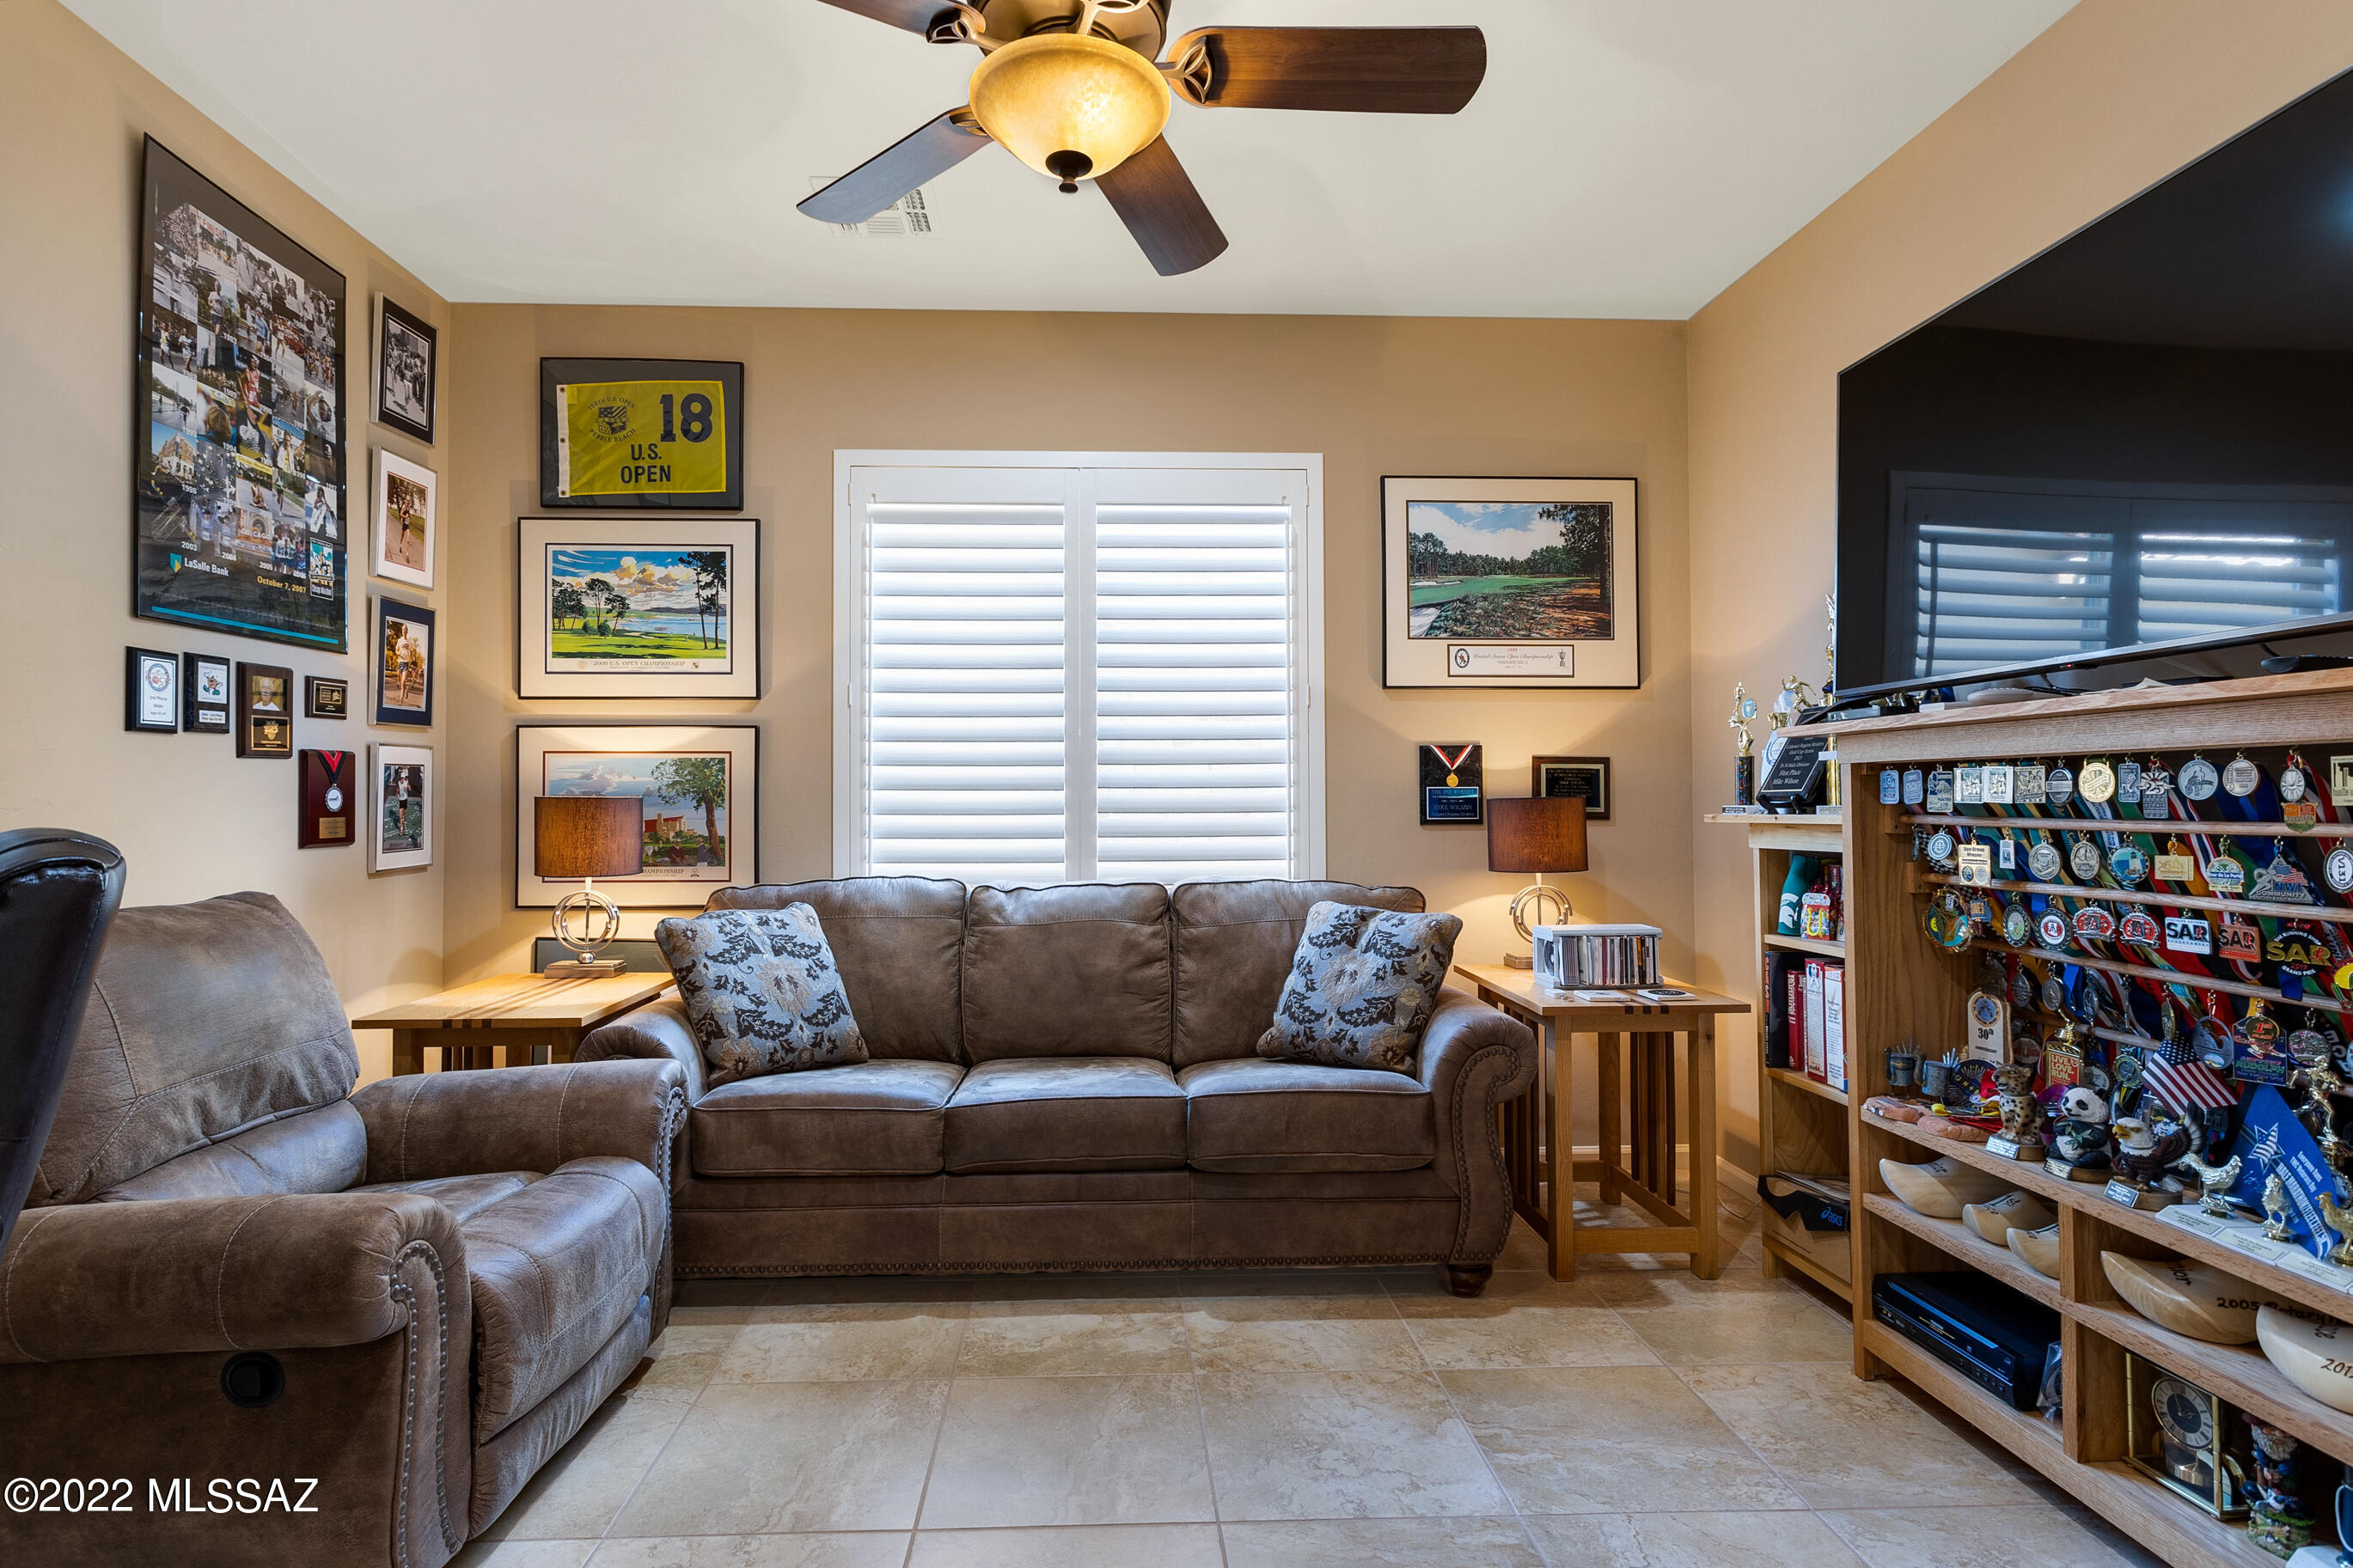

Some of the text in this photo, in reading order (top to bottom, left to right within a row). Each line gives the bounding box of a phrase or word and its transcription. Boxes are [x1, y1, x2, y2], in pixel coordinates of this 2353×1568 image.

[660, 394, 713, 443] 18
[614, 427, 636, 442] BEACH
[630, 443, 662, 461] U.S.
[620, 465, 671, 484] OPEN
[182, 485, 197, 495] 1998
[181, 541, 198, 552] 2003
[184, 558, 229, 577] LaSalle Bank
[259, 561, 273, 570] 2005
[257, 576, 284, 589] October
[292, 584, 307, 594] 2007
[2145, 781, 2165, 795] 25
[2275, 882, 2302, 893] NWI
[2167, 922, 2210, 943] SAR
[2218, 928, 2257, 950] SAR
[2308, 934, 2322, 946] SHOP
[2266, 941, 2332, 967] SAR
[2282, 965, 2302, 976] GRAND
[2051, 1052, 2070, 1065] LIVE.
[2051, 1061, 2075, 1075] LOVE.
[2051, 1070, 2071, 1081] RUN.
[2275, 1162, 2291, 1183] HALF
[2216, 1296, 2261, 1311] 2005
